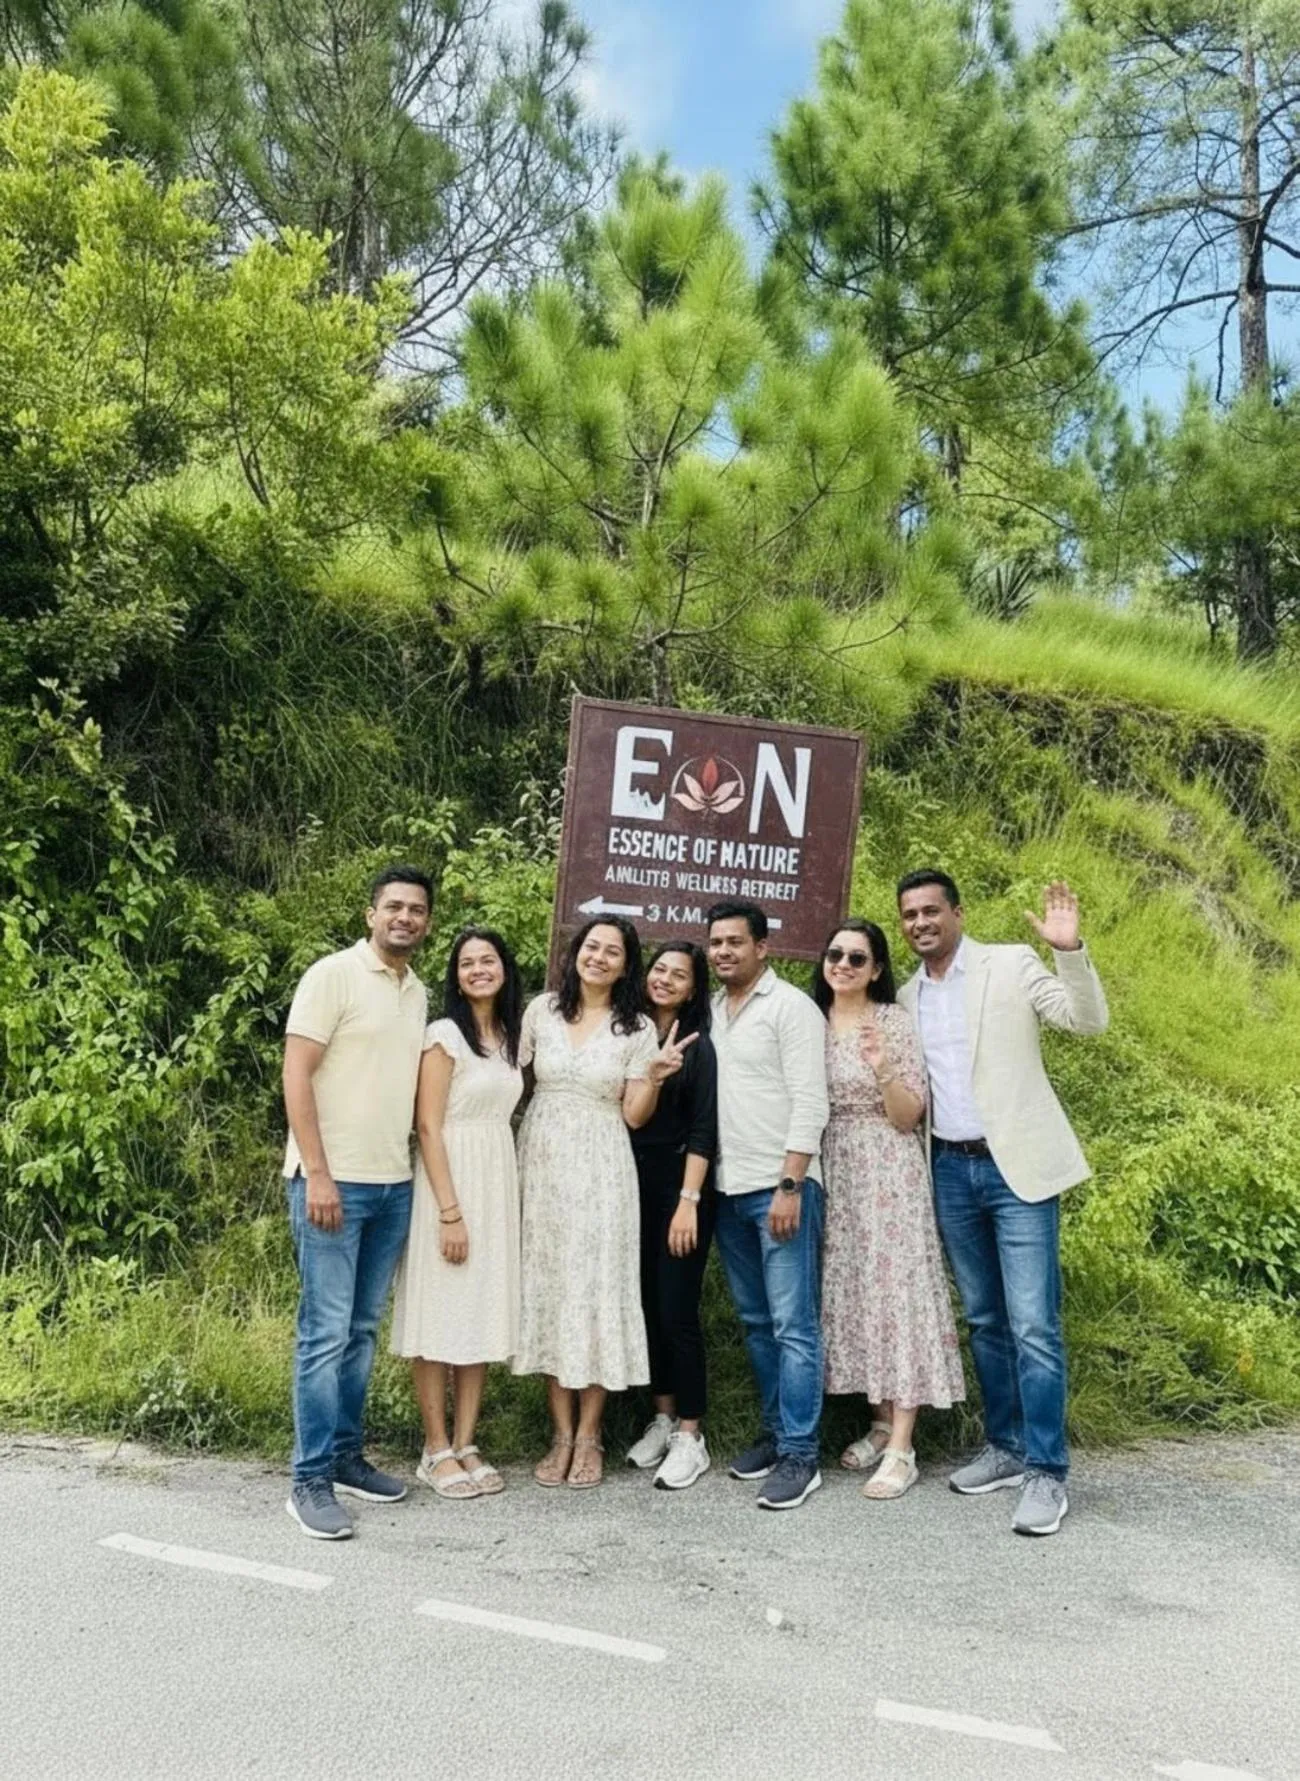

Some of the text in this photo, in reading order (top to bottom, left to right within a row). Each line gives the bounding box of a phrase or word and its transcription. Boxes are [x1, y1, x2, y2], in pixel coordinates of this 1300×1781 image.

[608, 827, 800, 875] ESSENCE OF NATURE
[646, 903, 661, 923] 3
